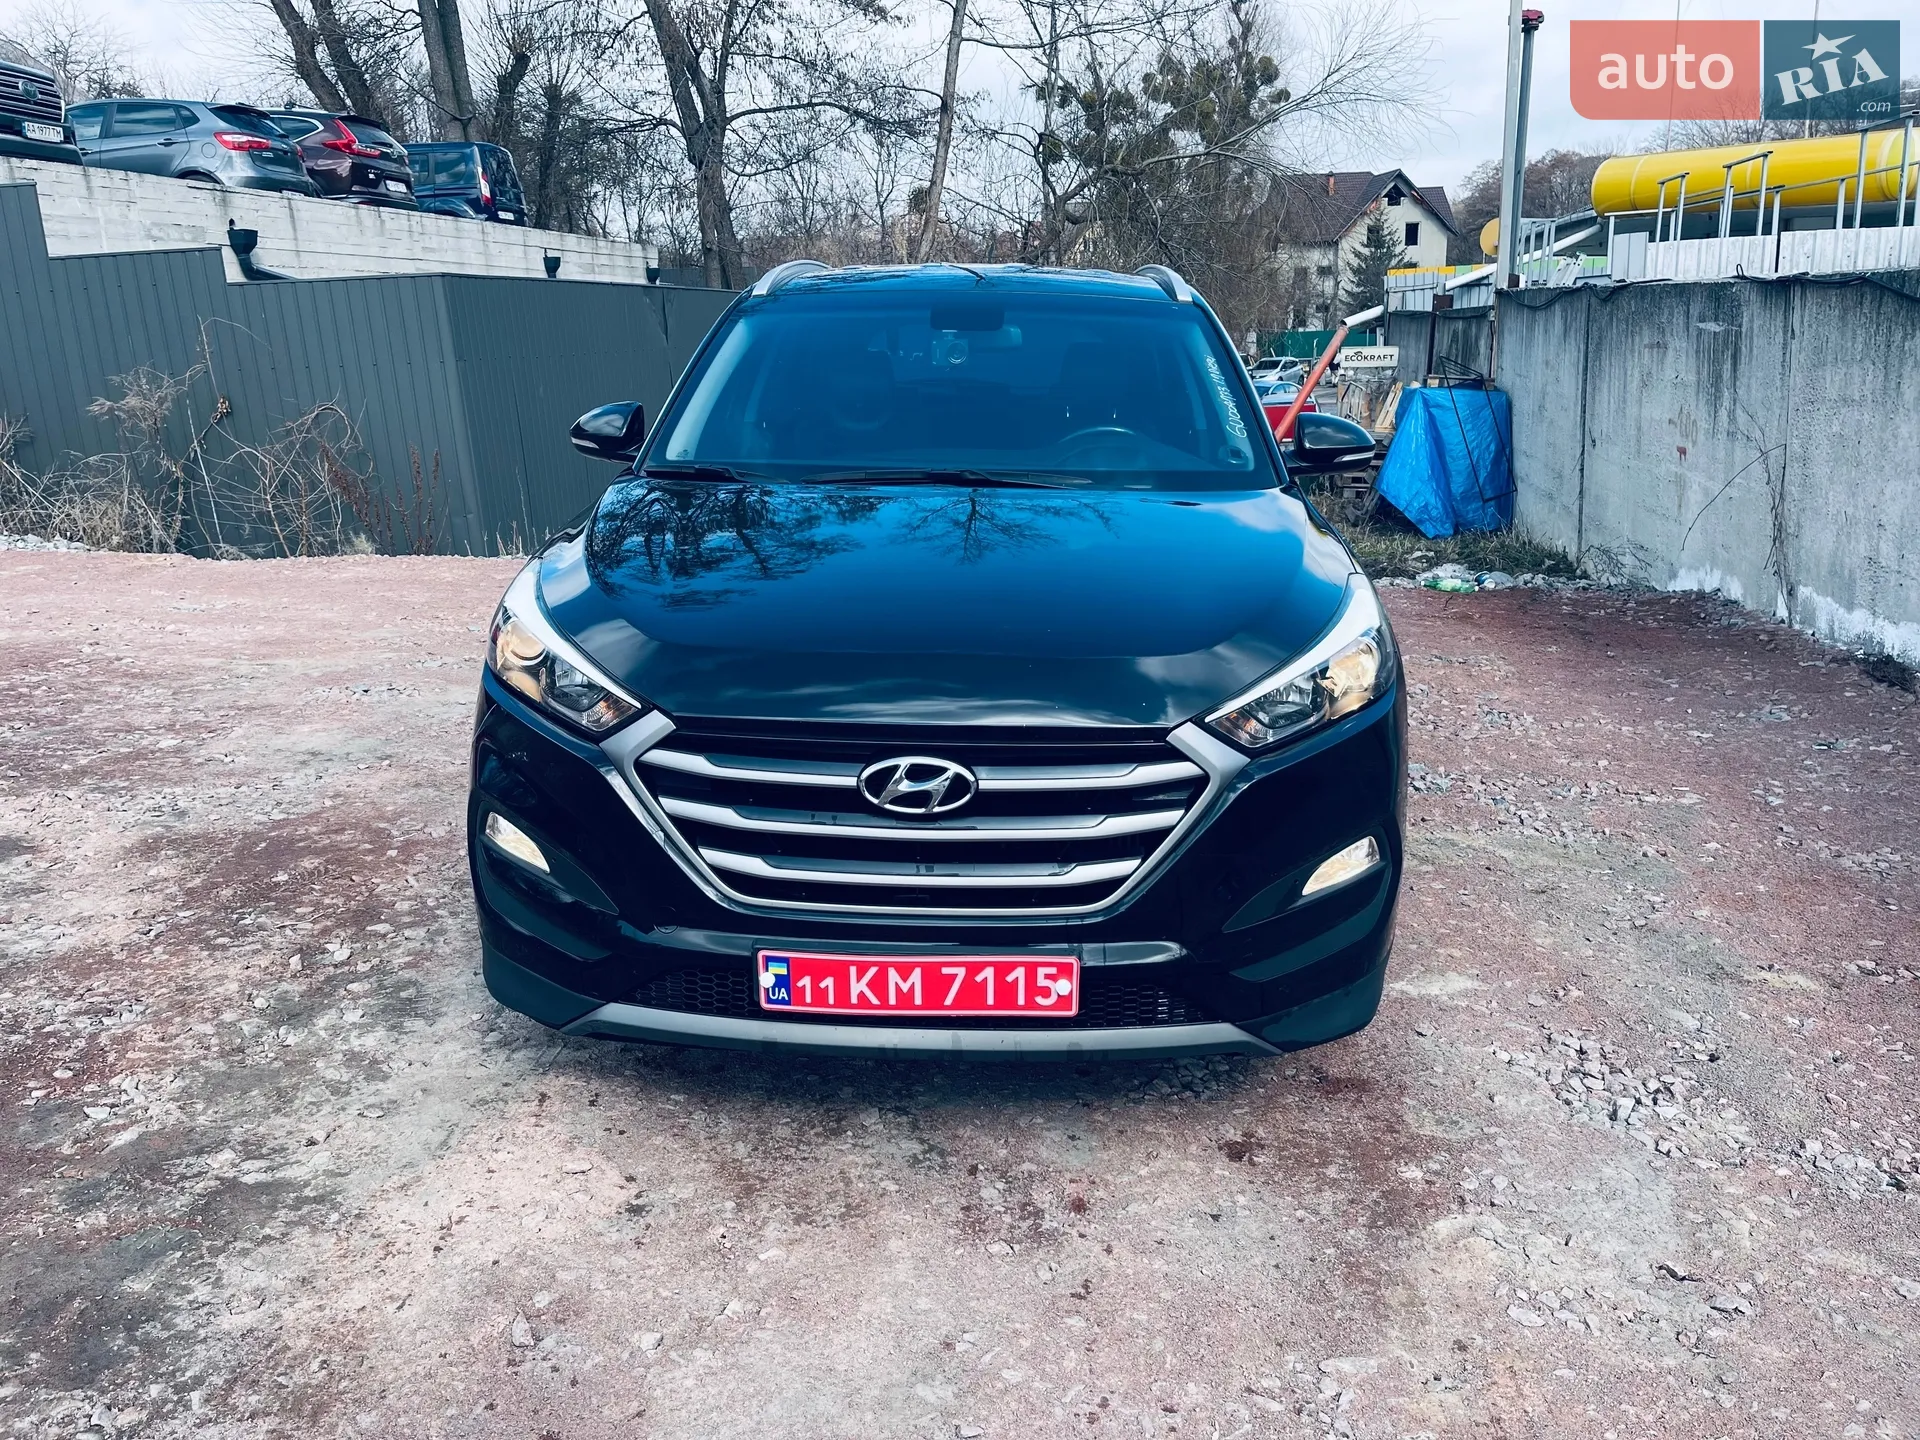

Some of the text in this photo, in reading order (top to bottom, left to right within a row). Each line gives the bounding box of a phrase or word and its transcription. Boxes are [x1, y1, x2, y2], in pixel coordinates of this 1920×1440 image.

[27, 124, 36, 134] AA
[51, 128, 62, 138] TM
[1344, 354, 1395, 362] ECOKRAFT
[796, 965, 1059, 1007] 11 KM 7115
[768, 986, 789, 1001] UA
